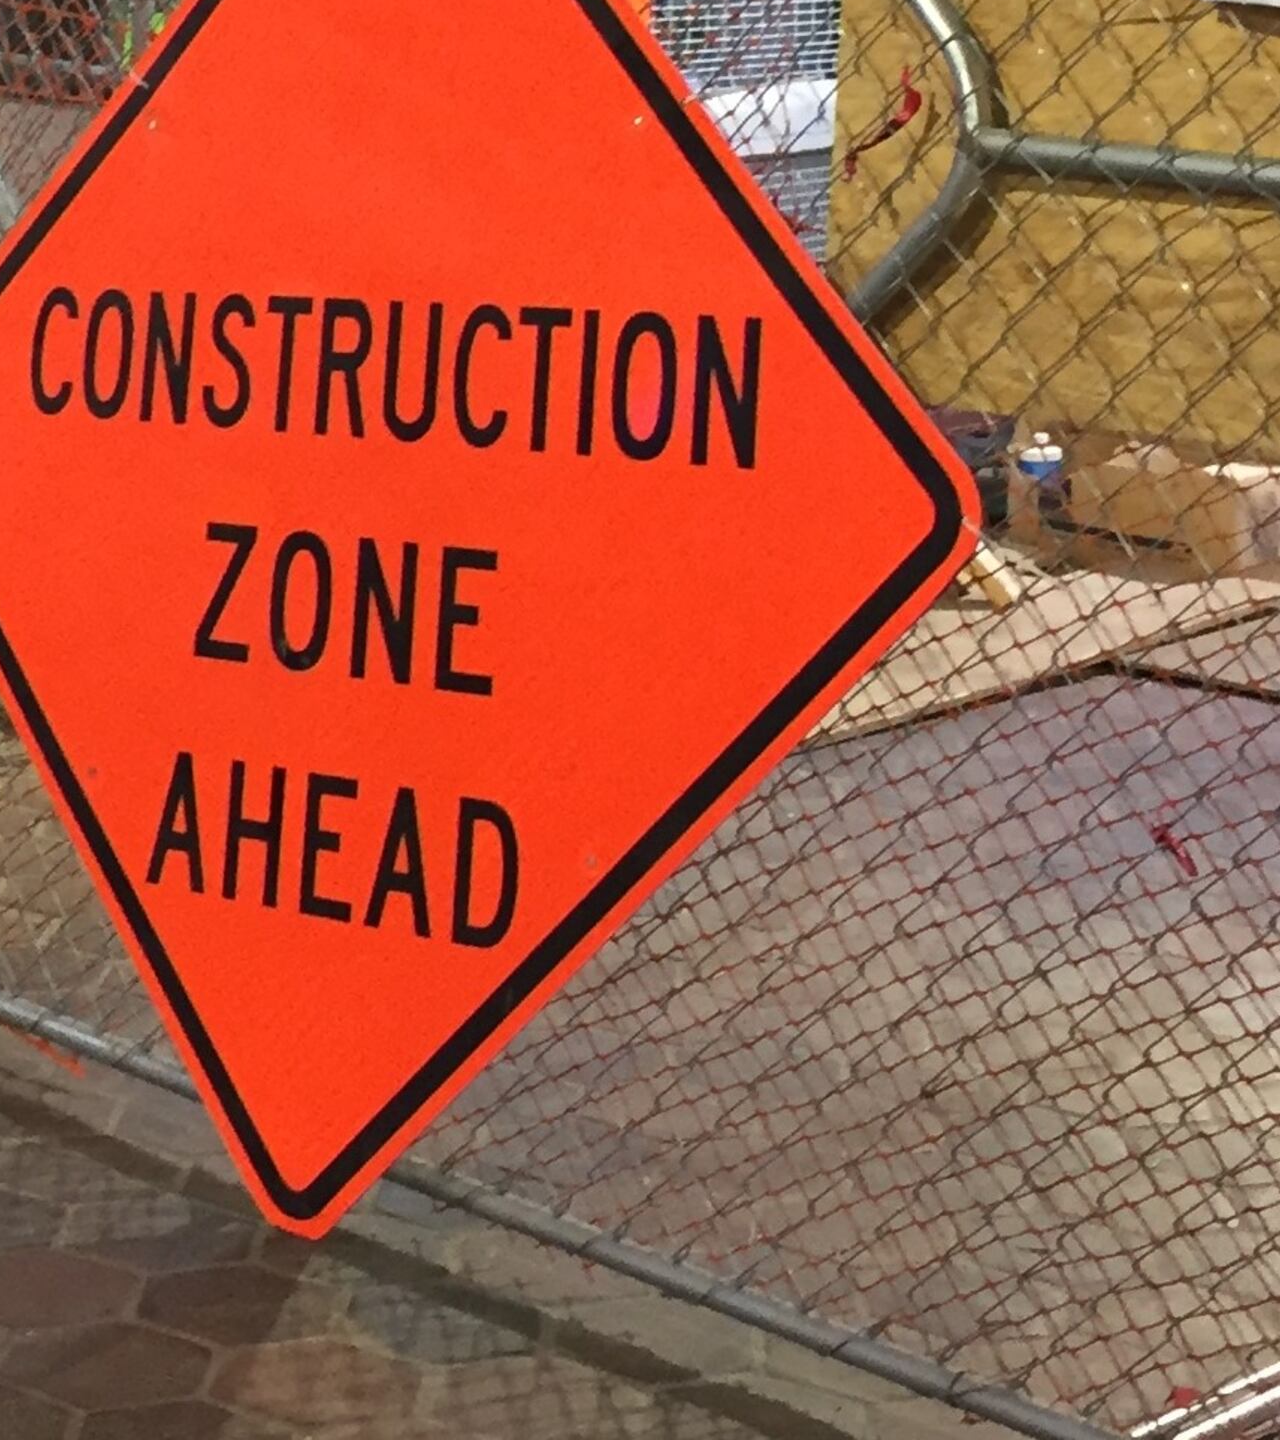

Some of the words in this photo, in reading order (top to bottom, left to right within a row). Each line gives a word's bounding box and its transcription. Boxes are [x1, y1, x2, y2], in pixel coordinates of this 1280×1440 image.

[29, 286, 763, 471] CONSTRUCTION
[192, 521, 499, 697] ZONE
[144, 751, 520, 949] AHEAD
